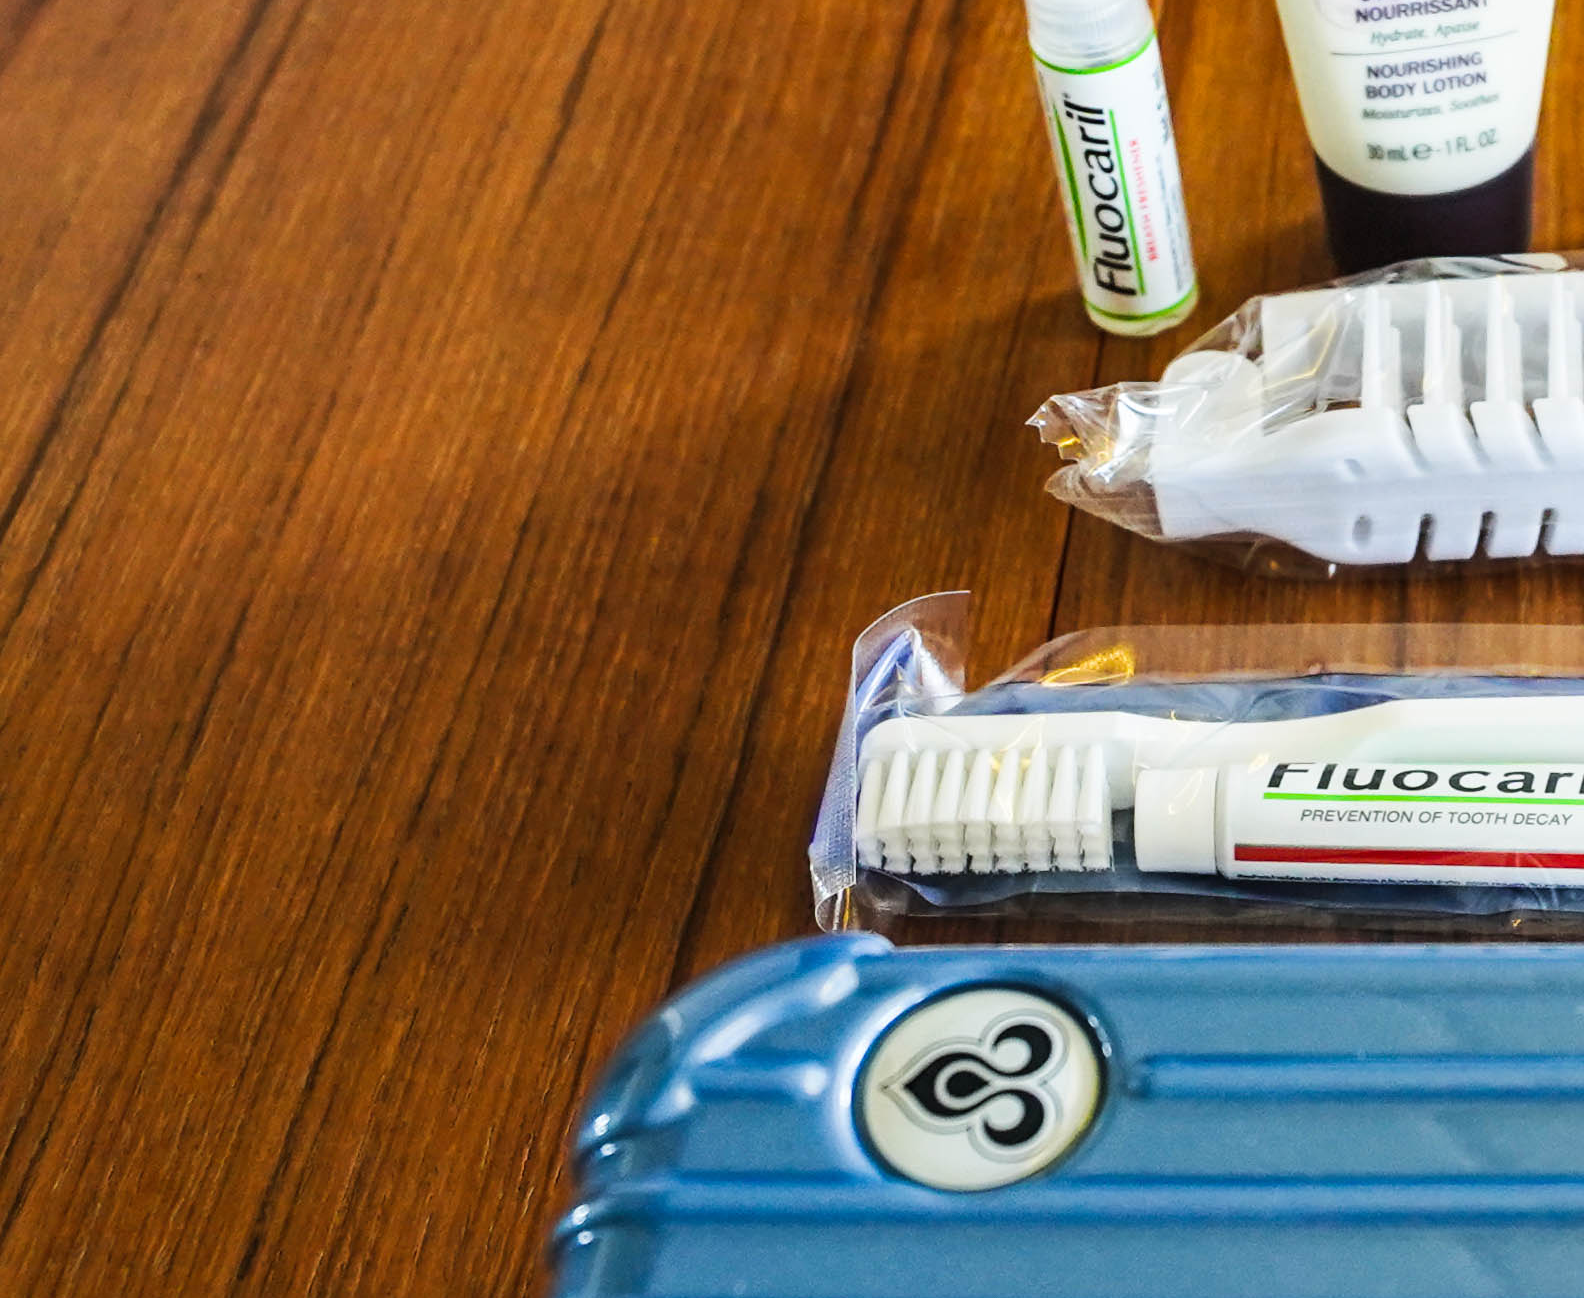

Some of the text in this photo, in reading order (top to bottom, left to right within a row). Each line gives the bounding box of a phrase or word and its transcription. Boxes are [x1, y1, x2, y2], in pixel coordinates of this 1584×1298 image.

[1366, 51, 1484, 80] NOURISHING
[1364, 71, 1488, 100] BODY LOTION
[1300, 808, 1574, 827] PREVENTION OF TOOTH DECAY
